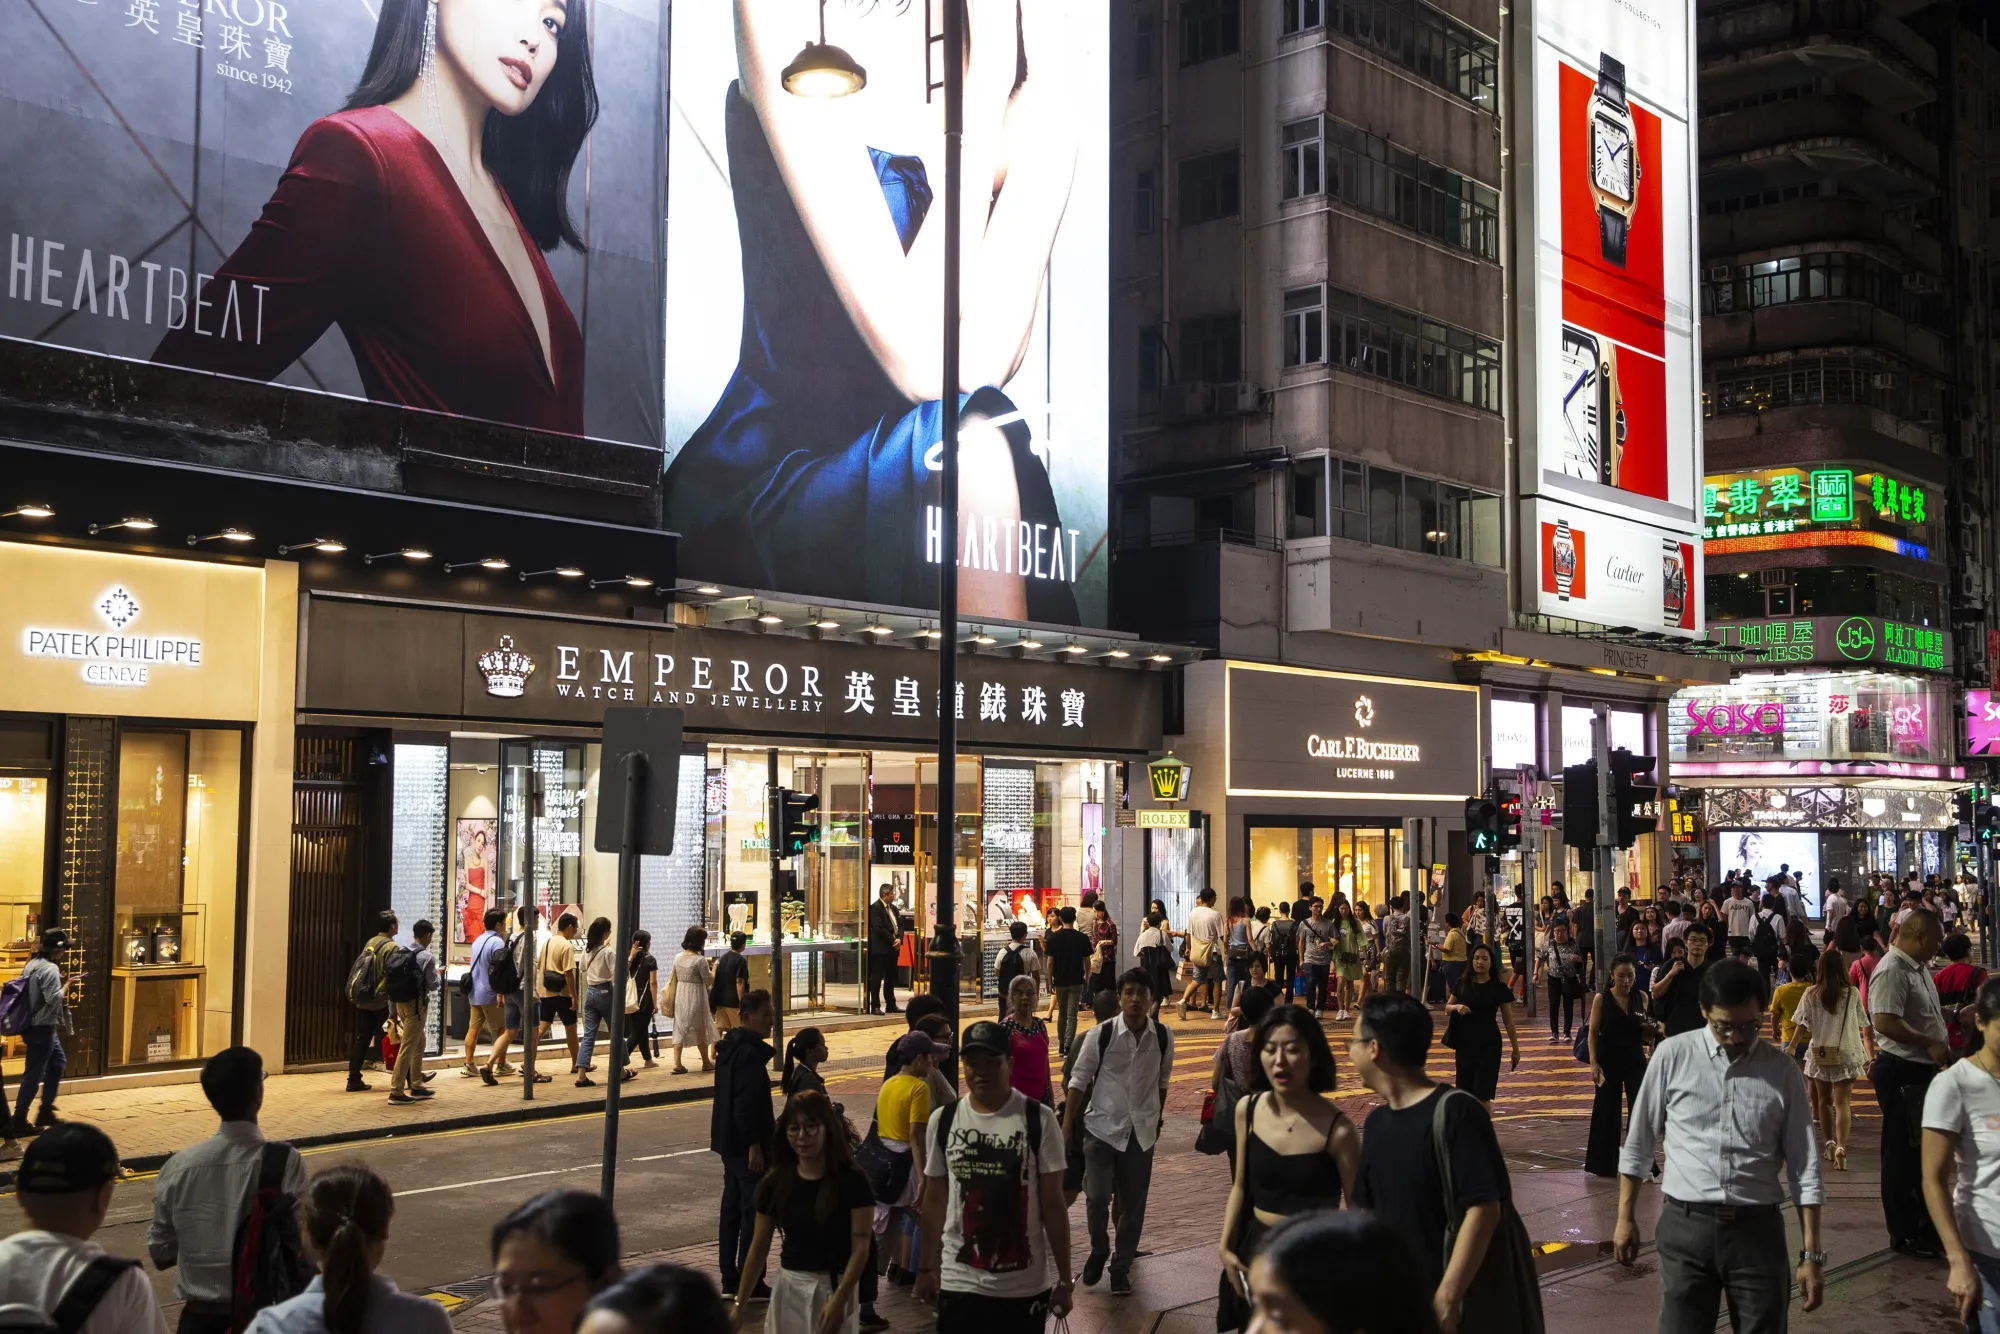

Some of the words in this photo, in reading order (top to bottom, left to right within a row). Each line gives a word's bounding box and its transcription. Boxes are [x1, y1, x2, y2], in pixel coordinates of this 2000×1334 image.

[124, 0, 292, 74] 英皇珠寶
[216, 61, 258, 85] since
[261, 72, 292, 95] 1942
[9, 233, 270, 345] HEARTBEAT
[926, 505, 1080, 582] HARTBEAT
[1606, 554, 1644, 584] Cartier
[29, 631, 100, 656] PATEK
[106, 637, 201, 662] PHILIPPE
[1885, 646, 1918, 665] ALADIN
[1921, 652, 1944, 670] MESS
[87, 665, 147, 682] GENEVE
[556, 645, 823, 697] EMPEROR
[556, 684, 634, 701] WATCH
[653, 691, 696, 705] AND
[710, 693, 823, 713] JEWELLERY
[1307, 734, 1344, 758] CARL
[1356, 738, 1420, 761] BUCHERER
[1336, 767, 1374, 779] LUCERNE
[1376, 769, 1394, 780] 1888
[1142, 814, 1187, 825] ROLEX
[742, 839, 770, 849] ROLE
[883, 844, 911, 853] TUDOR
